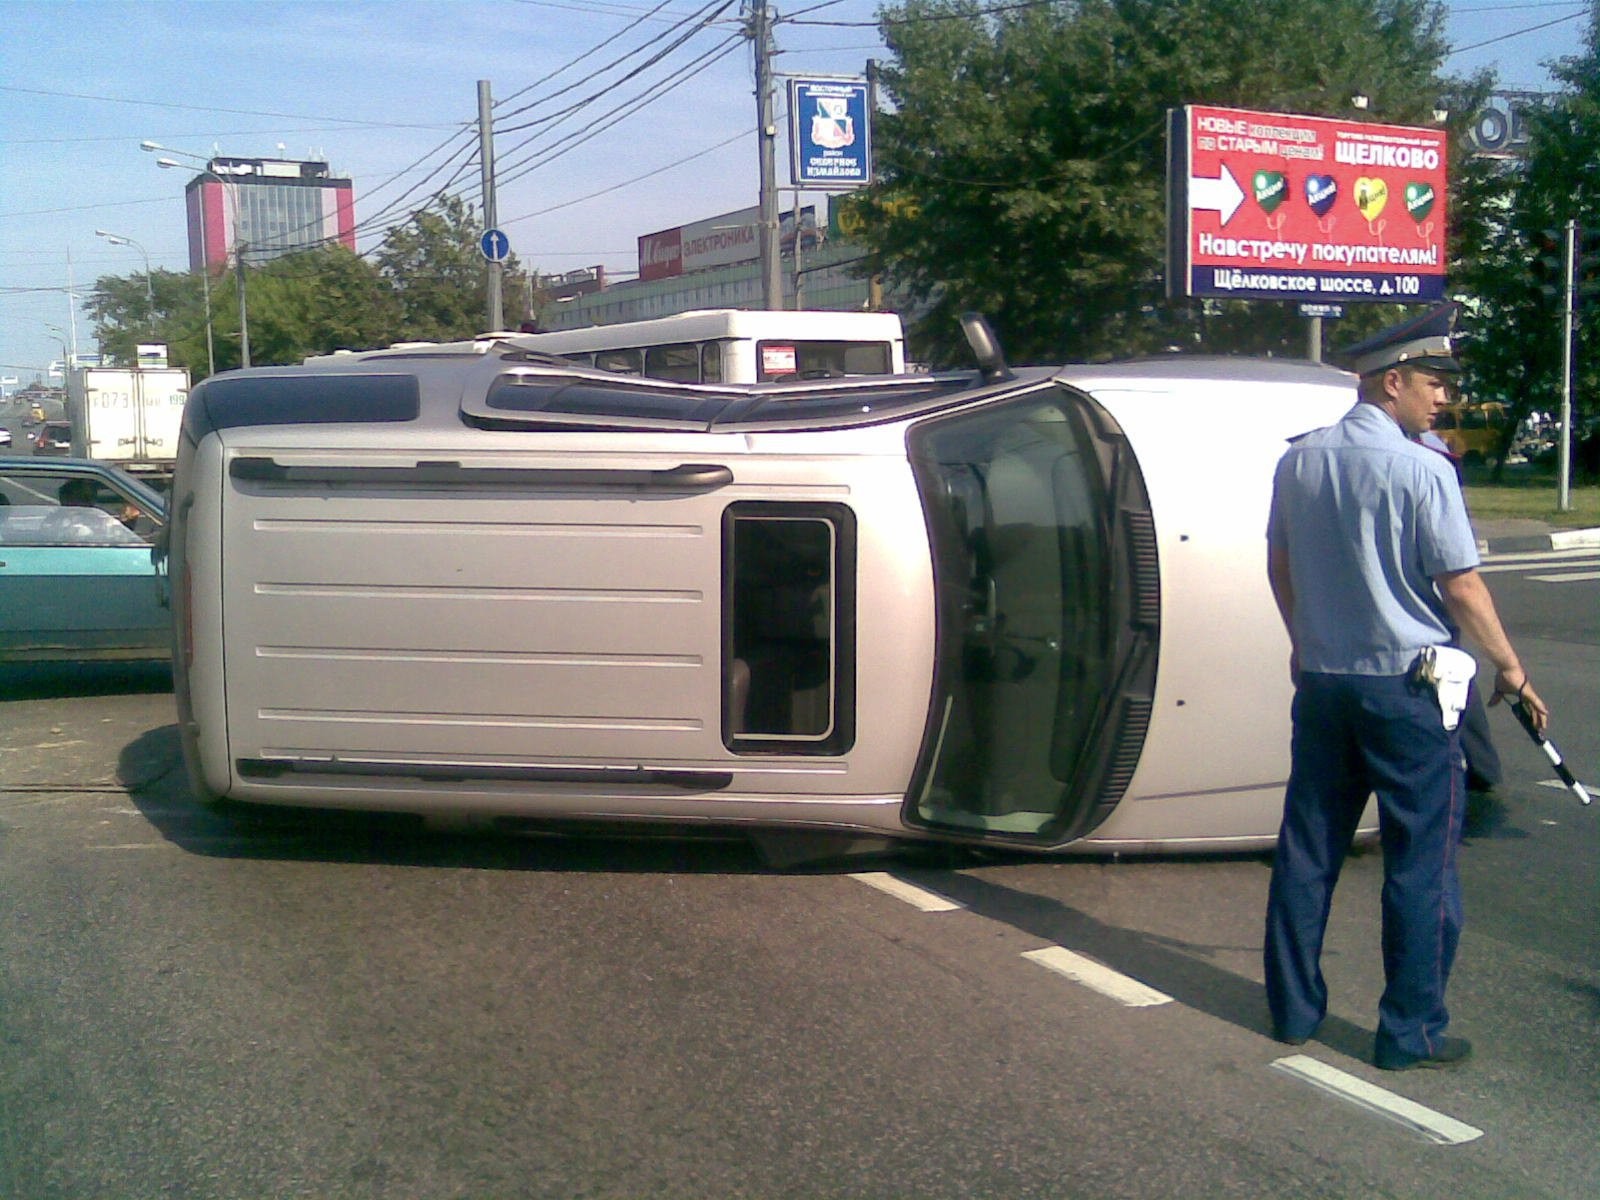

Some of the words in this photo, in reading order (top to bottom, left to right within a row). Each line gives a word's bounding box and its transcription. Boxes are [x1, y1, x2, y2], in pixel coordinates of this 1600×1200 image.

[1197, 117, 1248, 135] НОВЫЕ
[1218, 136, 1278, 156] СТАРЫМ
[1335, 141, 1439, 170] ЩЕЛКОВО
[683, 226, 756, 258] ЭЛЕКТРОНИКА
[1199, 232, 1308, 265] Навстречу
[1312, 243, 1437, 267] покупателям!
[1213, 268, 1317, 292] Щёлковское
[1320, 276, 1377, 296] шоссе,
